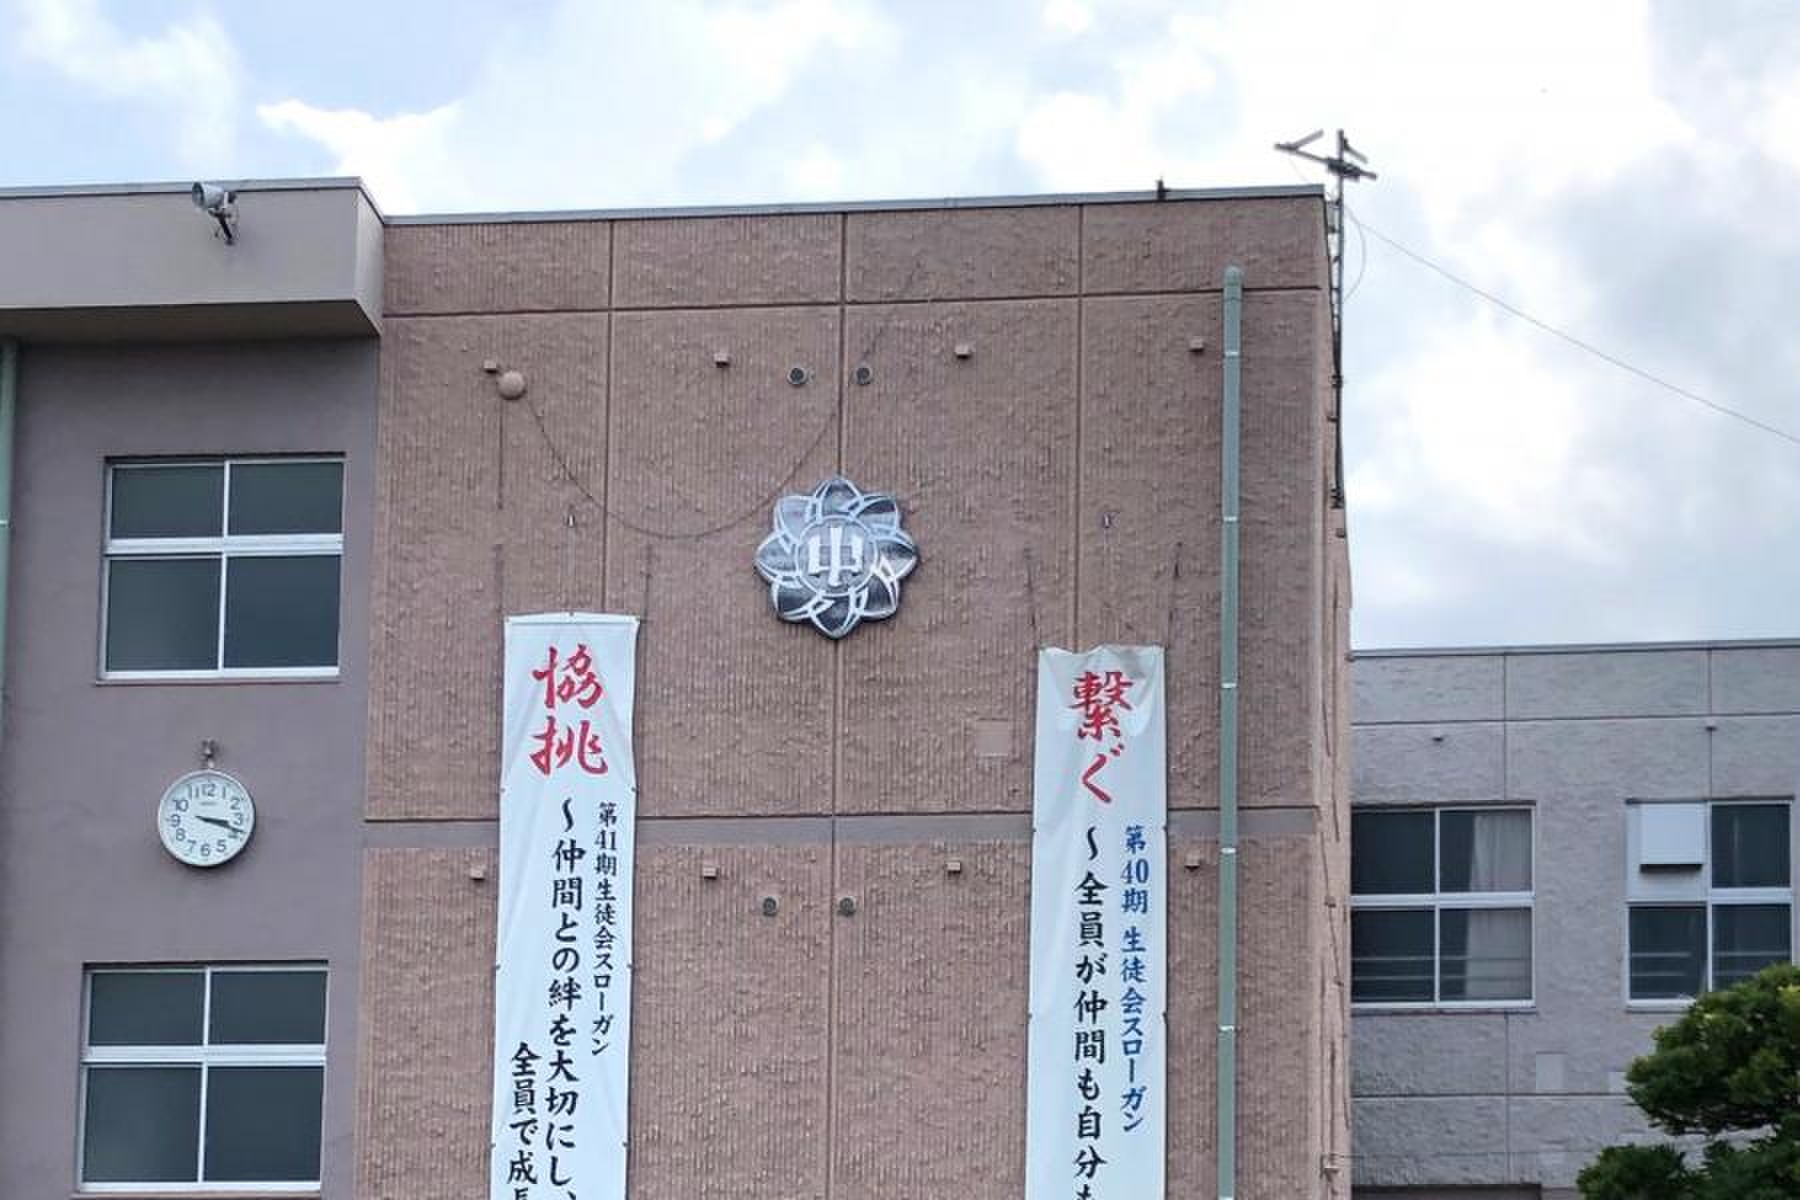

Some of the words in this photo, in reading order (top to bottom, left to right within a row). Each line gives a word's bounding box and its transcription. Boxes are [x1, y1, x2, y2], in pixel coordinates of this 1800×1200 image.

[532, 645, 608, 775] 協挑
[1072, 670, 1134, 804] 繋ぐ
[201, 783, 216, 797] 12
[172, 799, 189, 812] 10
[231, 797, 241, 810] 2
[171, 814, 181, 827] 9
[233, 812, 244, 826] 3
[175, 827, 186, 842] 8
[188, 839, 196, 851] 7
[200, 843, 211, 857] 6
[216, 839, 226, 853] 5
[1120, 824, 1150, 915] 第40期
[591, 802, 618, 1056] 第41期生徒会スローガン
[1121, 925, 1147, 1132] 生徒会スローガン
